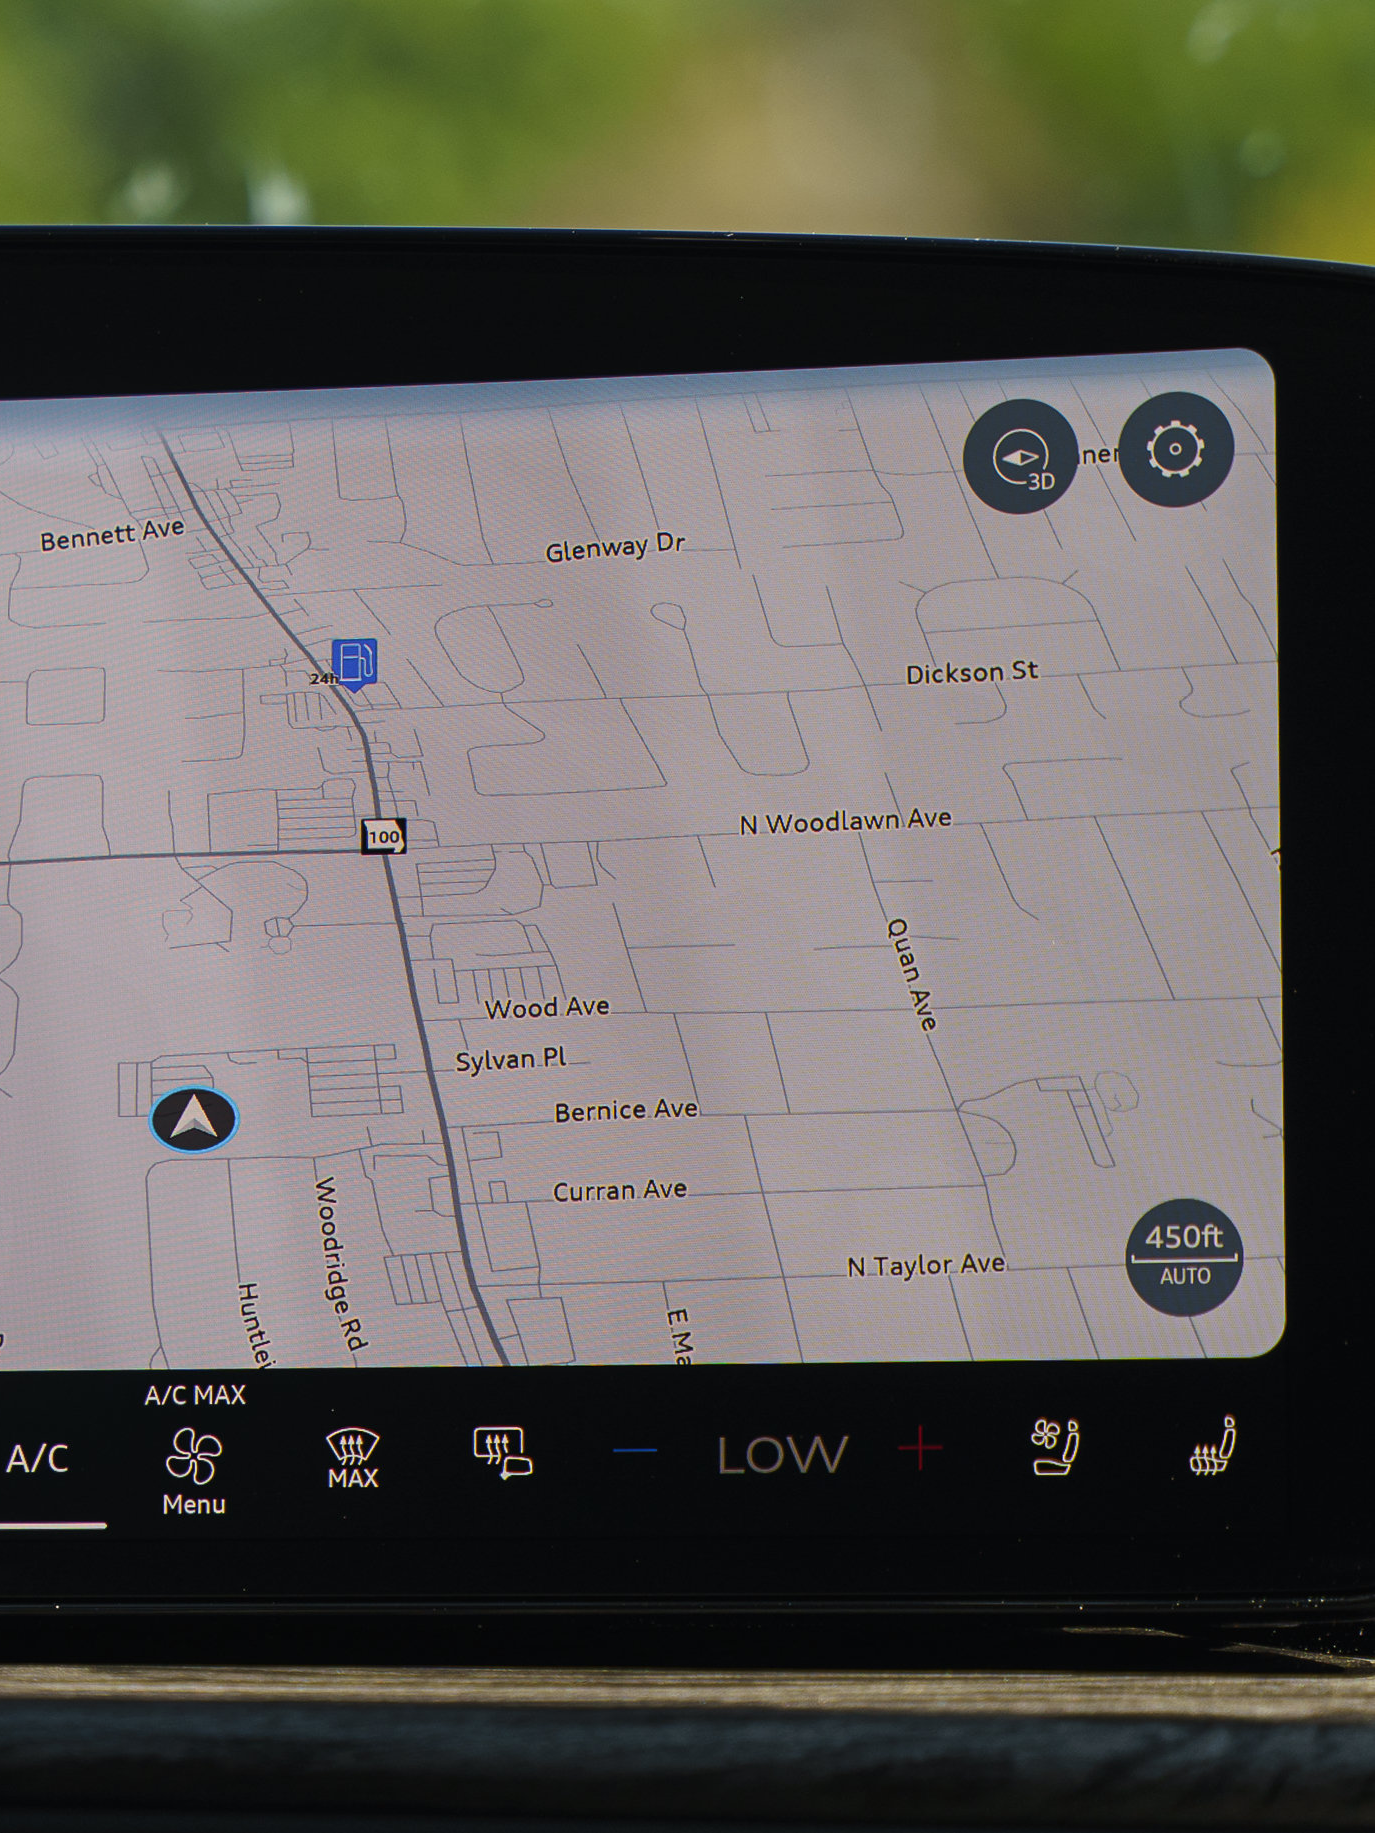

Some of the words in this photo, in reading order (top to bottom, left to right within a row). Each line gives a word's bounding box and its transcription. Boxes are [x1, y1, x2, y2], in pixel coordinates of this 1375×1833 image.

[1077, 447, 1120, 465] ner
[1028, 472, 1056, 491] 3D
[41, 525, 136, 552] Bennett
[143, 520, 184, 540] Ave
[546, 539, 647, 562] Glenway
[656, 532, 686, 552] Dr
[309, 673, 339, 685] 24h
[907, 662, 1004, 685] Dickson
[1012, 660, 1039, 680] St
[741, 815, 757, 835] N
[765, 810, 899, 834] Woodlawn
[908, 808, 952, 829] Ave
[369, 830, 400, 844] 100
[888, 918, 920, 983] Quan
[910, 990, 936, 1031] Ave
[484, 996, 558, 1020] Wood
[566, 996, 609, 1016] Ave
[456, 1049, 535, 1077] Sylvan
[544, 1045, 567, 1067] Pl
[556, 1100, 646, 1123] Bernice
[654, 1098, 698, 1118] Ave
[554, 1182, 635, 1202] Curran
[643, 1179, 687, 1199] Ave
[1145, 1223, 1224, 1249] 450ft
[315, 1176, 349, 1314] Woodridge
[340, 1318, 369, 1352] Rd
[848, 1257, 865, 1277] N
[873, 1254, 953, 1282] Taylor
[961, 1253, 1005, 1274] Ave
[1160, 1266, 1211, 1285] AUTO
[667, 1308, 689, 1326] E
[144, 1385, 187, 1406] A/C
[194, 1384, 246, 1406] MAX
[5, 1442, 69, 1473] A/C
[719, 1435, 849, 1474] LOW
[328, 1468, 379, 1488] MAX
[163, 1493, 226, 1515] Menu
